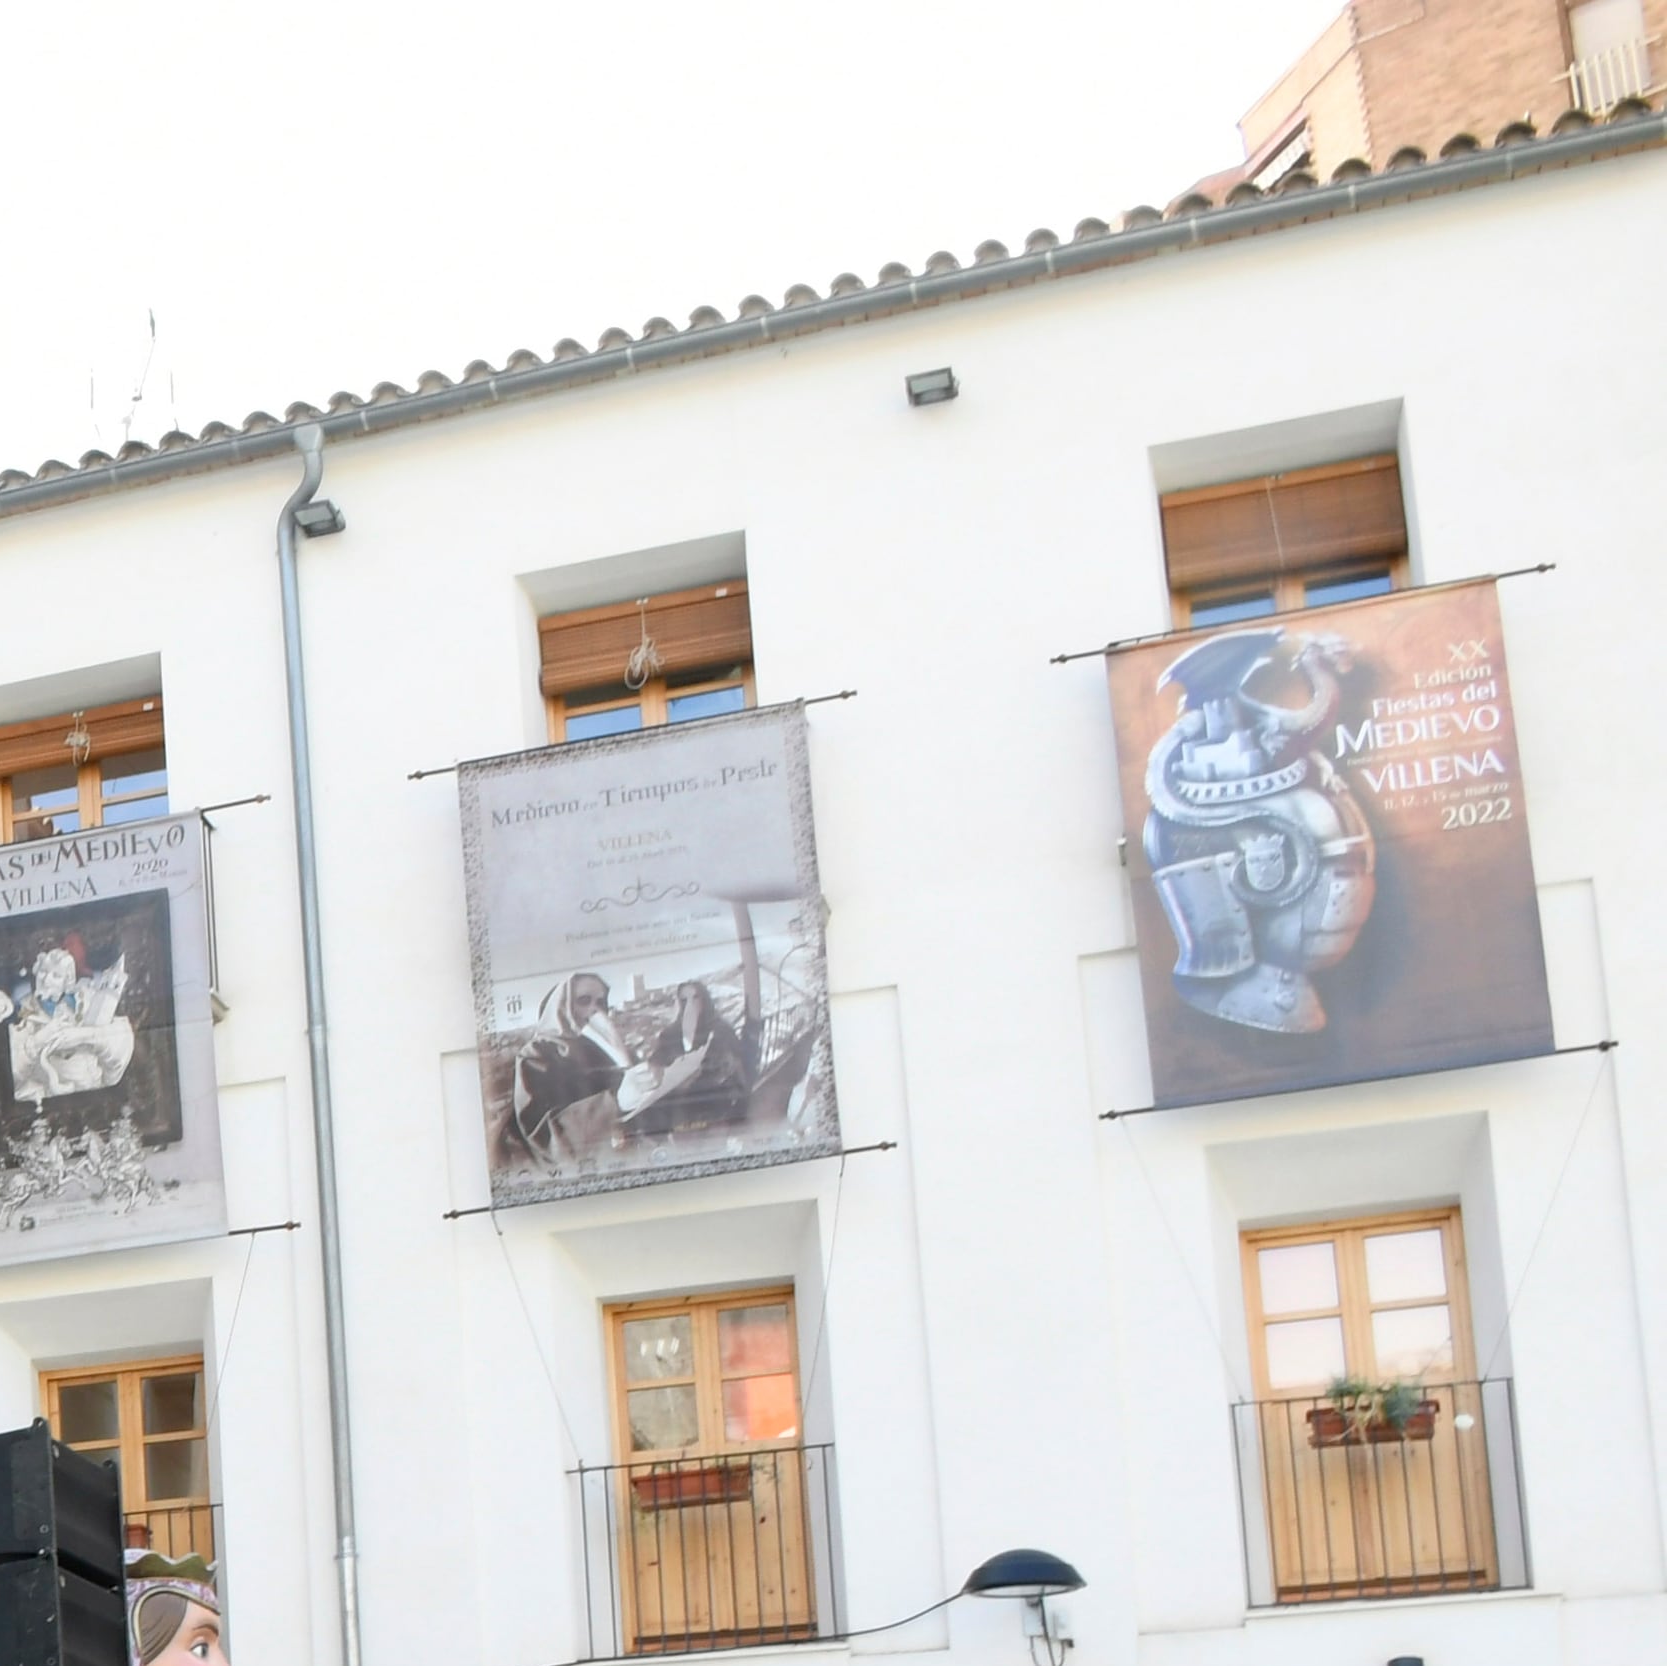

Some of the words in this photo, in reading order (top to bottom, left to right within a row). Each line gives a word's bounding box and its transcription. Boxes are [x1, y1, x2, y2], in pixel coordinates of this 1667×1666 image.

[1447, 640, 1490, 663] XX
[1413, 664, 1492, 689] Edición
[1373, 690, 1455, 718] Fiestas
[1462, 680, 1497, 703] del
[1335, 704, 1500, 759] MEDIEVO
[1360, 748, 1506, 794] VILLENA
[490, 798, 581, 830] Medievo
[598, 774, 700, 809] Tiempos
[718, 756, 779, 788] Peste
[1443, 797, 1513, 830] 2022
[596, 827, 674, 852] VILLENA
[132, 858, 170, 877] 2020
[0, 874, 99, 912] VILLENA
